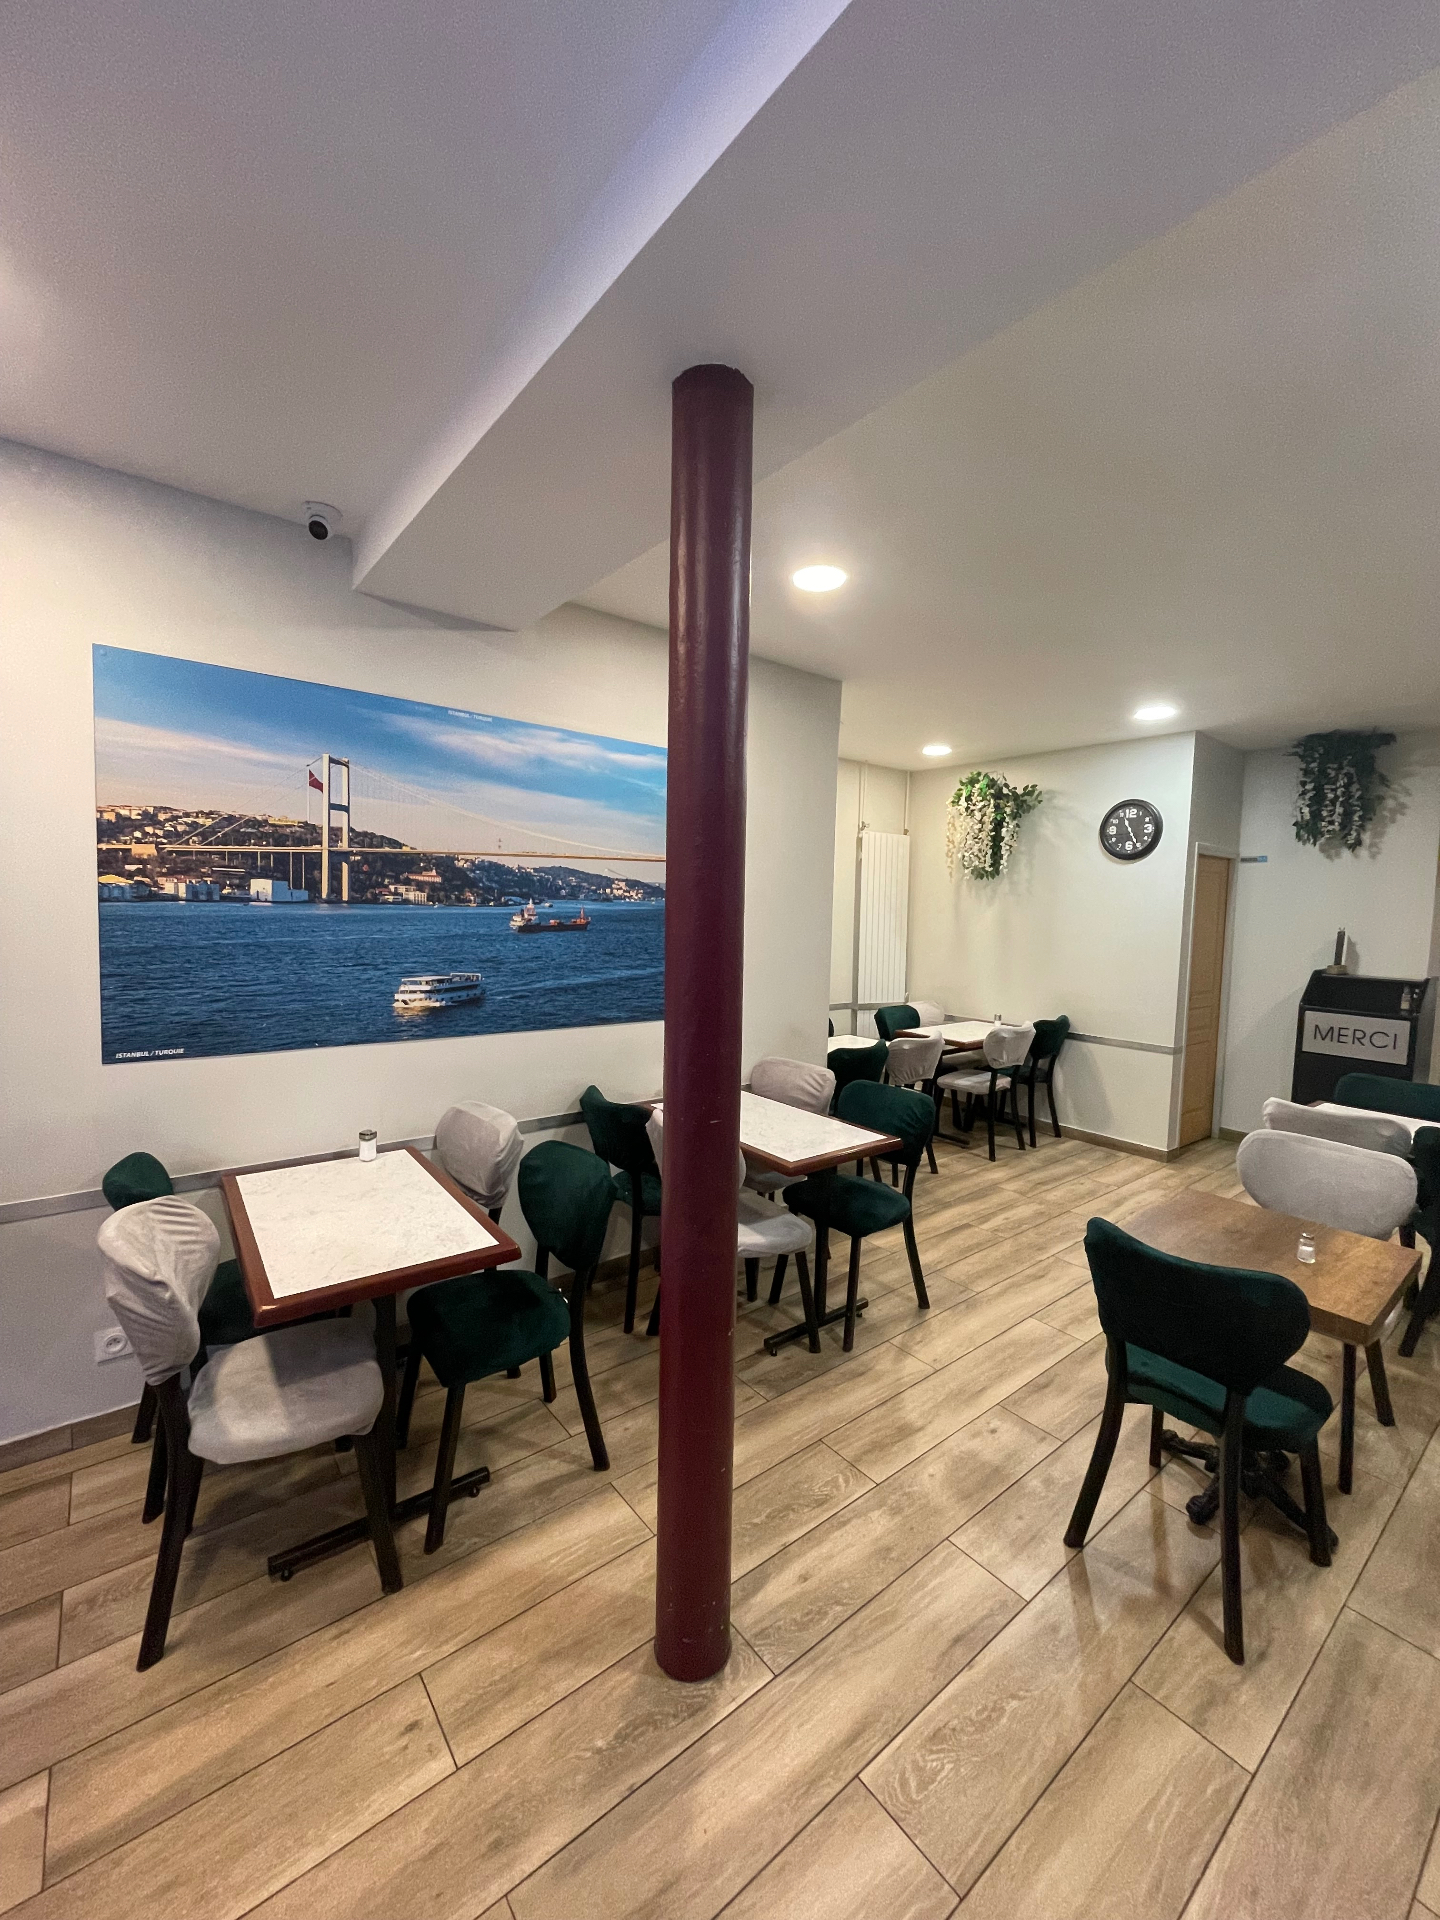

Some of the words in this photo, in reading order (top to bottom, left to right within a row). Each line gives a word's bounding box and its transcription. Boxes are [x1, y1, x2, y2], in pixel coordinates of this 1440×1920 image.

[1125, 808, 1138, 818] 12
[1109, 825, 1117, 835] 9
[1143, 824, 1153, 833] 3
[1125, 840, 1133, 850] 6
[1313, 1024, 1398, 1050] MERCI
[115, 1051, 149, 1059] ISTANBUL
[155, 1048, 185, 1056] TURQUIE
